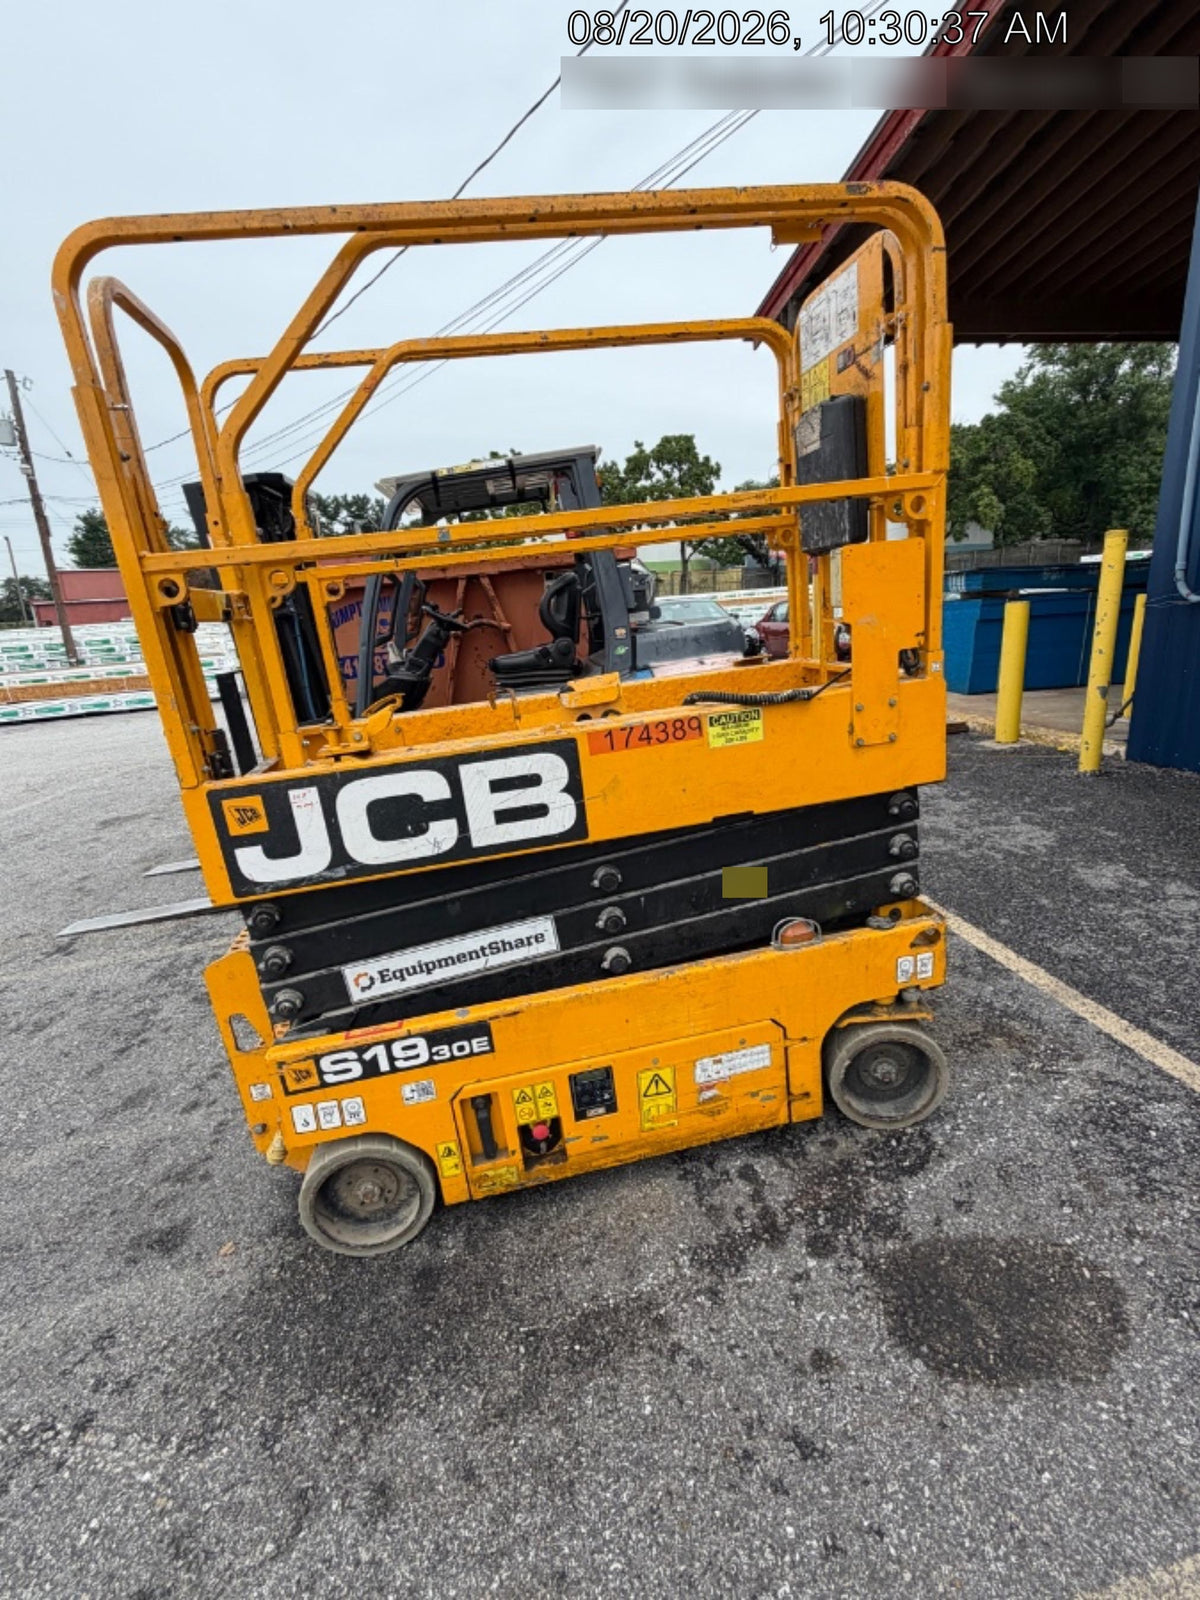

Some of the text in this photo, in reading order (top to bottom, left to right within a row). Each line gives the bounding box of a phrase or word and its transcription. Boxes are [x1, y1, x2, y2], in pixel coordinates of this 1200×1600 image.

[604, 715, 703, 751] 174389
[711, 708, 760, 727] CAUTION
[234, 752, 578, 883] JCB
[377, 930, 546, 985] EquipmentShare
